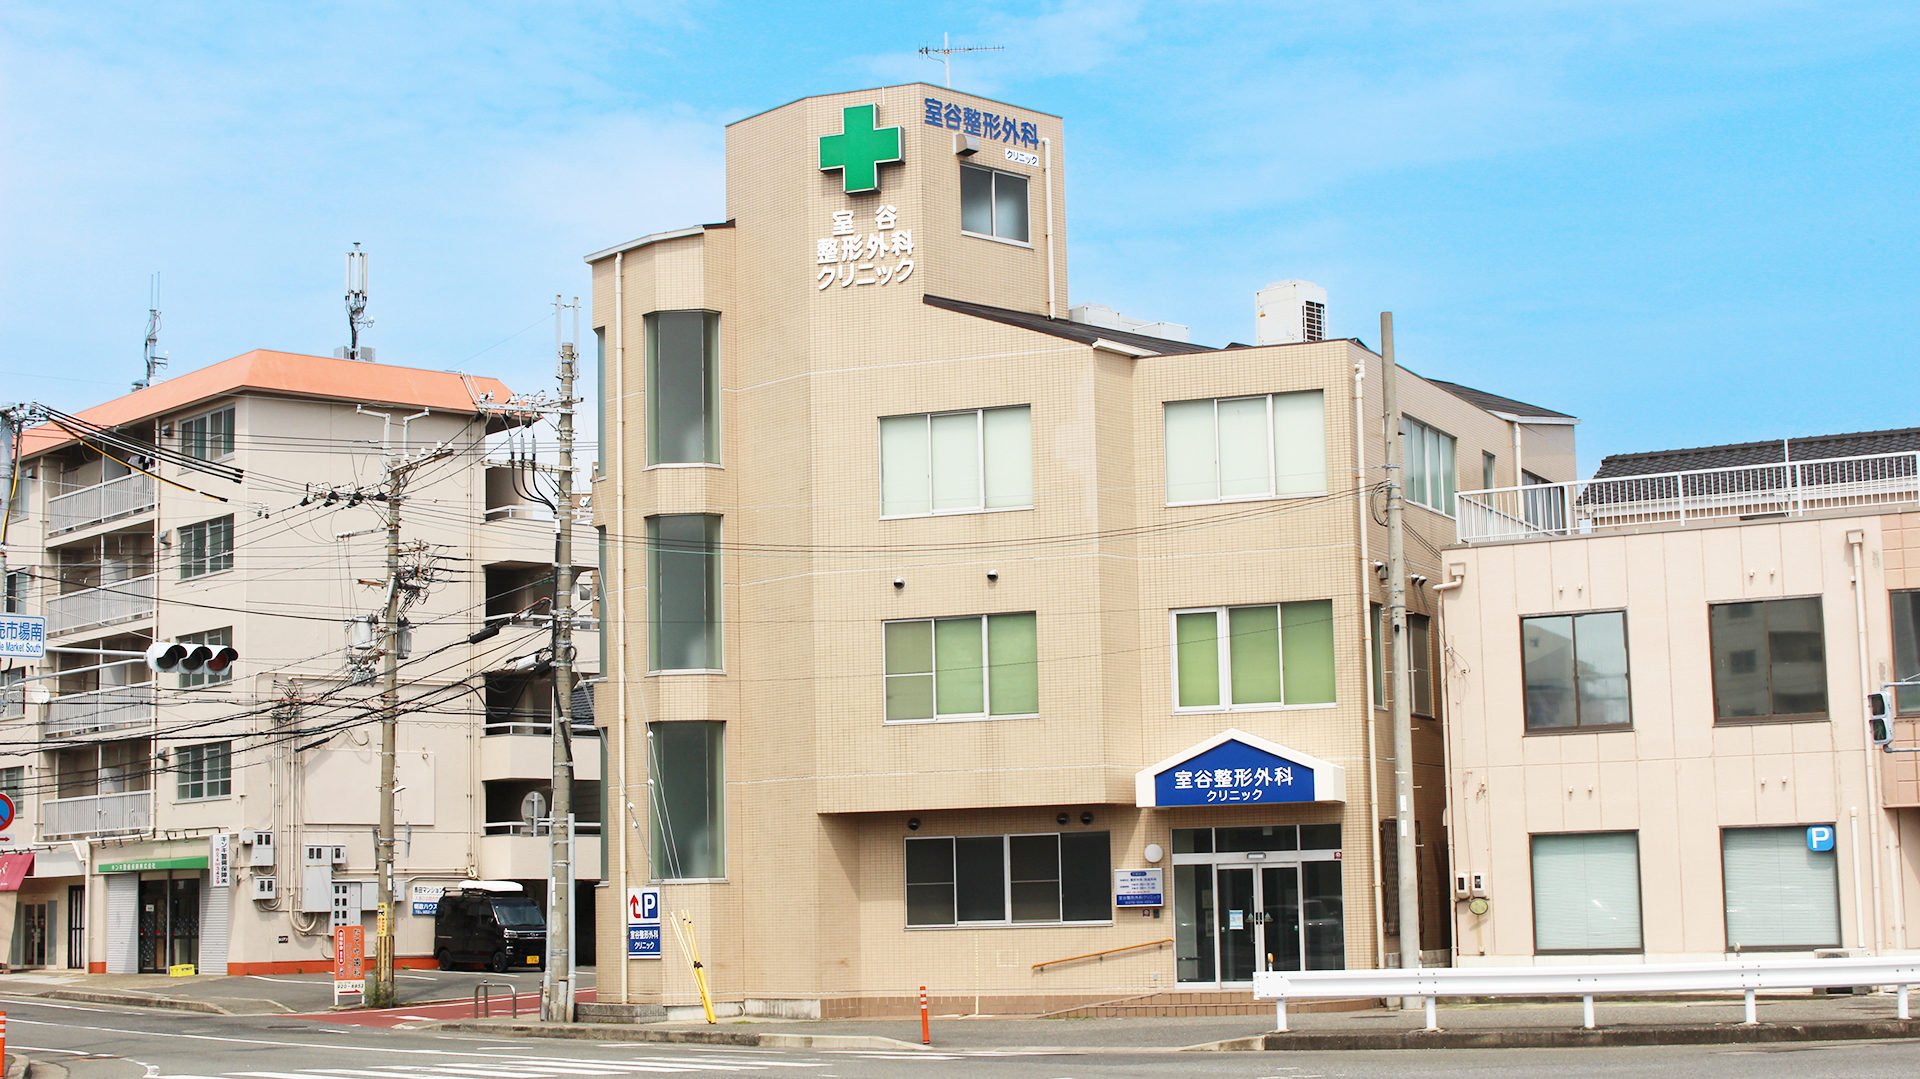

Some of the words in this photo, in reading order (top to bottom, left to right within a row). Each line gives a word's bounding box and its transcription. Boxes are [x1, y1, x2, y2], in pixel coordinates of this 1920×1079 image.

[924, 97, 1039, 150] 室谷整形外科
[1006, 150, 1038, 165] クリニック
[816, 229, 915, 265] 整形外科
[816, 258, 915, 290] クリニック
[6, 642, 24, 652] Market
[25, 642, 41, 653] South
[1174, 766, 1294, 790] 室谷整形外科
[1206, 788, 1263, 802] クリニック
[1812, 827, 1829, 848] P
[644, 893, 656, 917] P
[630, 930, 659, 940] 室谷整形外科
[634, 941, 655, 950] クリニック
